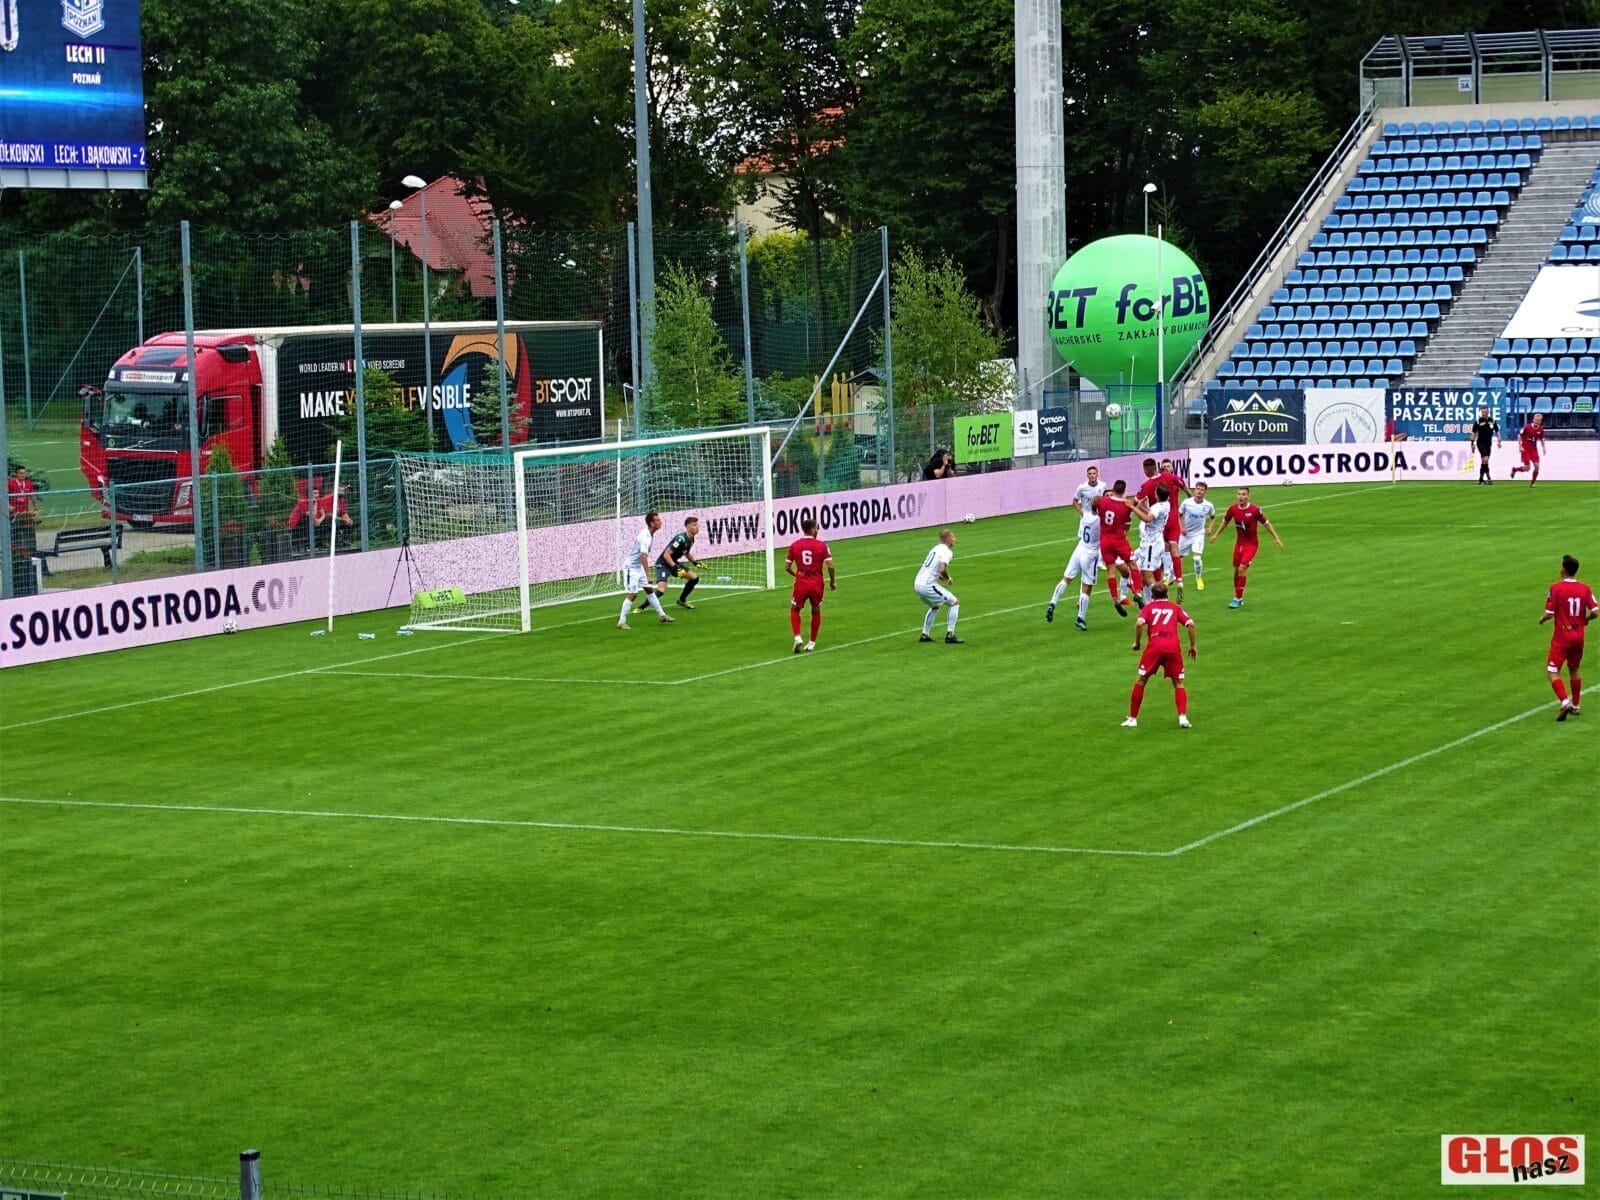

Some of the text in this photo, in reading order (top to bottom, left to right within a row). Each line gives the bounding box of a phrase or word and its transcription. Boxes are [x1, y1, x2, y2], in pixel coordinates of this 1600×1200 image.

[66, 45, 92, 63] LECH
[72, 72, 101, 84] POZNAŃ
[54, 145, 79, 164] LECH:
[140, 147, 145, 165] 2
[299, 363, 317, 374] WORLD
[319, 362, 338, 373] LEADER
[383, 360, 406, 369] SCREENS
[535, 377, 592, 404] BTSPORT
[1392, 391, 1501, 406] PRZEWOZY
[300, 391, 344, 419] MAKE
[418, 384, 471, 410] VSIBLE
[967, 424, 1000, 446] forBET
[1222, 419, 1288, 435] Złoty Dom
[1422, 424, 1442, 433] TEL.
[1104, 510, 1115, 525] 8
[1083, 525, 1091, 544] 6
[802, 551, 812, 565] 6
[1567, 597, 1581, 617] 11
[1151, 608, 1174, 626] 77
